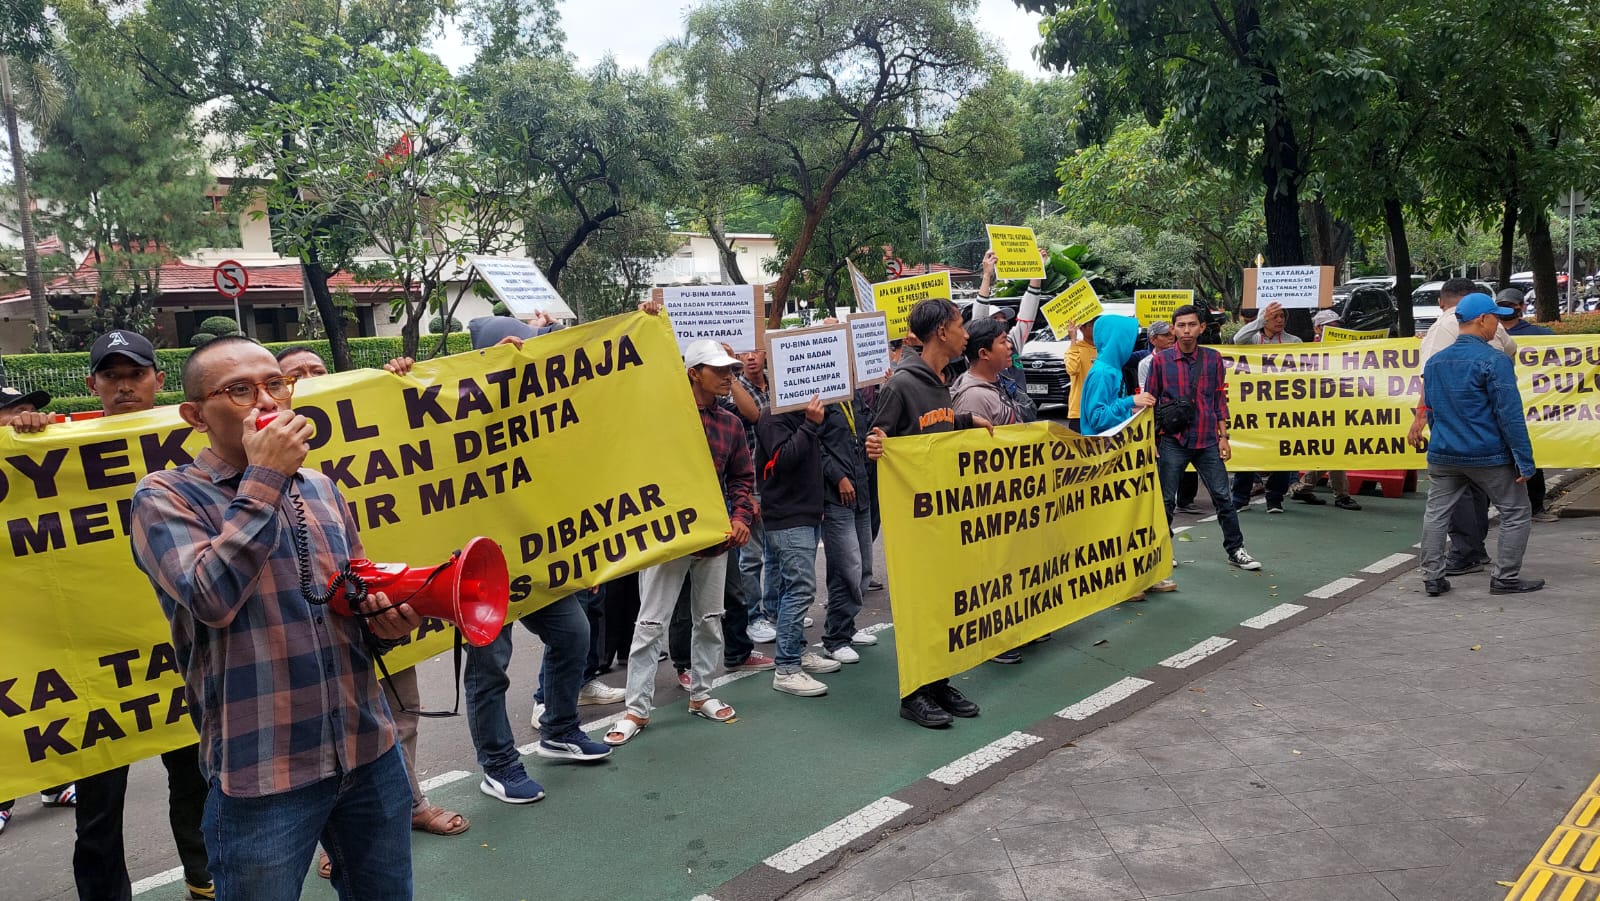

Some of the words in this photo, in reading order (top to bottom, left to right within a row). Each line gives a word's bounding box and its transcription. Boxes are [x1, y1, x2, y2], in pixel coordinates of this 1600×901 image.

[677, 330, 694, 338] TOL
[697, 329, 743, 338] KATARAJA
[780, 339, 810, 350] PU-BINA
[812, 336, 838, 346] MARGA
[787, 361, 836, 374] PERTANAHAN
[790, 353, 804, 362] DAN
[807, 350, 832, 359] BADAN
[1261, 350, 1330, 374] KAMI
[403, 334, 644, 430] KATARAJA
[778, 388, 820, 400] TANGGUNG
[822, 383, 846, 392] JAWAB
[784, 377, 810, 388] SALING
[812, 372, 840, 382] LEMPAR
[1240, 376, 1376, 402] PRESIDEN
[1265, 407, 1336, 429] TANAH
[1345, 407, 1401, 426] KAMI
[958, 443, 1044, 477] PROYEK
[1049, 440, 1075, 461] OL
[1279, 436, 1336, 457] BARU
[1344, 436, 1406, 455] AKAN
[7, 498, 132, 557] ME
[453, 397, 580, 464] DERITA
[418, 456, 533, 517] MATA
[913, 473, 1046, 518] BINAMARGA
[1052, 445, 1154, 493] EMENTERIAN
[960, 505, 1040, 546] RAMPAS
[1090, 471, 1155, 507] RAKYAT
[519, 483, 666, 566] DIBAYAR
[548, 507, 698, 590] DITUTUP
[954, 579, 1013, 617] BAYAR
[1019, 553, 1069, 588] TANAH
[1074, 535, 1122, 570] KAMI
[948, 589, 1063, 653] KEMBALIKAN
[1067, 562, 1127, 601] TANAH
